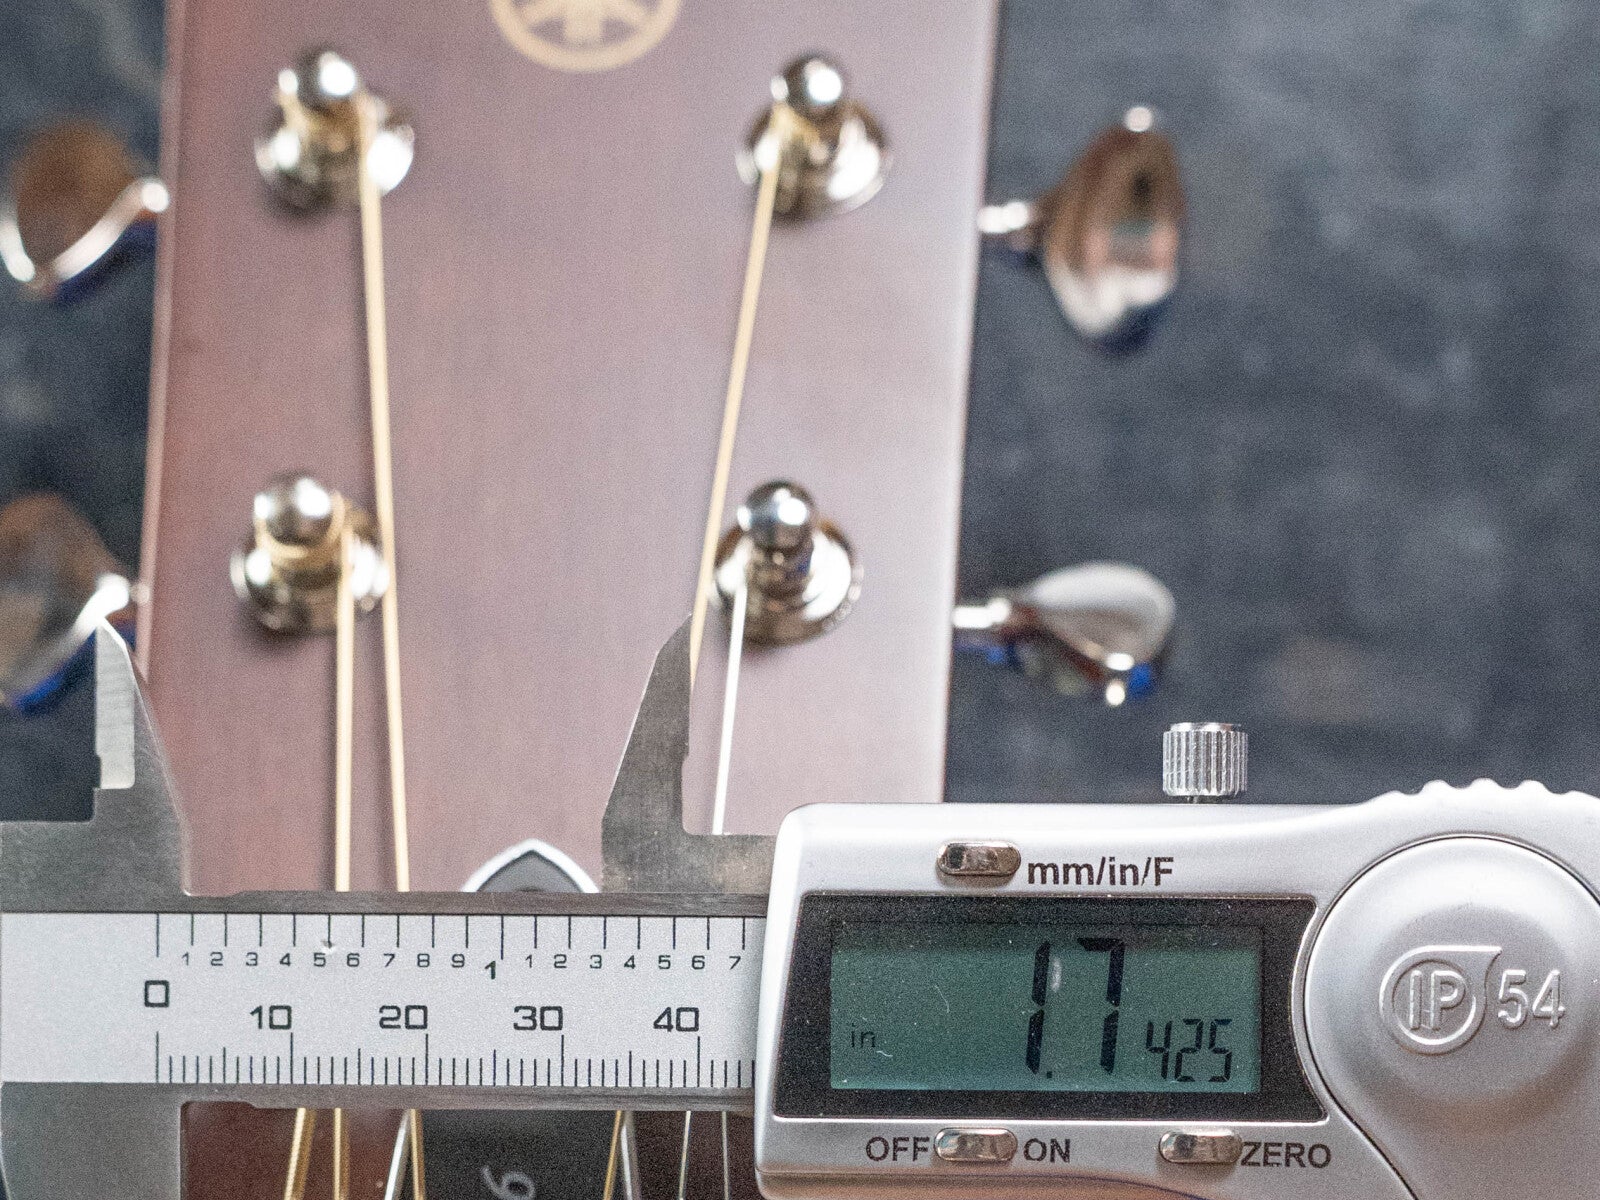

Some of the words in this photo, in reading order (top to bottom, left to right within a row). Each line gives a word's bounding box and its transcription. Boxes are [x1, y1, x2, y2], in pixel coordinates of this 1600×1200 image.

[1027, 856, 1174, 887] mm/in/F
[182, 952, 190, 966] 1
[210, 951, 224, 967] 2
[245, 951, 259, 967] 3
[279, 952, 292, 967] 4
[313, 951, 327, 968] 5
[346, 952, 360, 968] 6
[383, 953, 396, 967] 7
[416, 952, 431, 968] 8
[451, 953, 466, 969] 9
[484, 960, 496, 980] 1
[525, 954, 533, 968] 1
[553, 953, 568, 969] 2
[589, 954, 603, 970] 3
[623, 955, 636, 970] 4
[658, 954, 672, 970] 5
[691, 955, 706, 970] 6
[729, 955, 742, 970] 7
[143, 979, 170, 1008] 0
[249, 1004, 293, 1030] 10
[378, 1004, 429, 1031] 20
[512, 1005, 564, 1032] 30
[652, 1006, 700, 1033] 40
[1409, 969, 1466, 1030] IP
[1497, 969, 1566, 1029] 54
[850, 1023, 877, 1049] in
[865, 1135, 929, 1161] OFF
[1023, 1137, 1071, 1163] ON
[1240, 1141, 1332, 1169] ZERO
